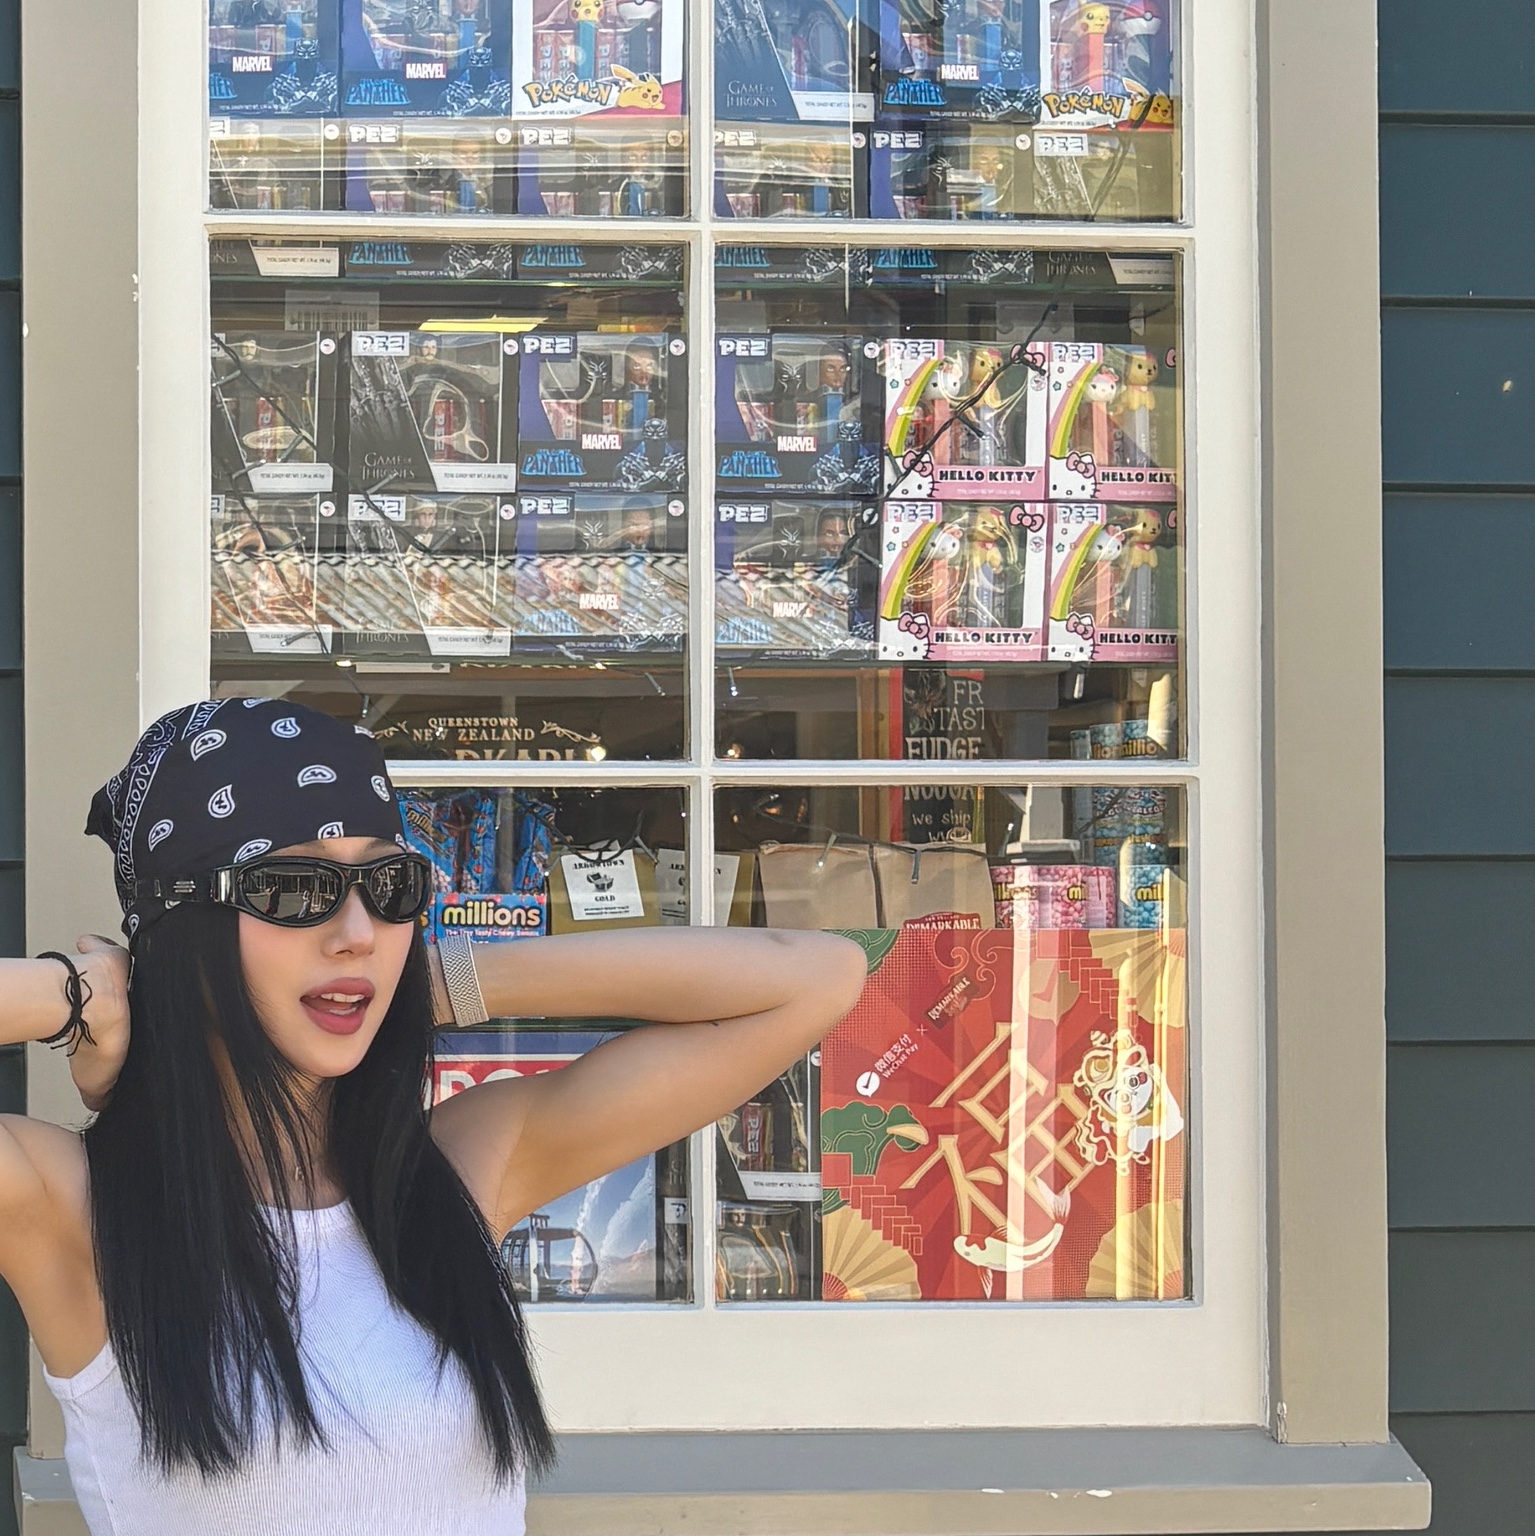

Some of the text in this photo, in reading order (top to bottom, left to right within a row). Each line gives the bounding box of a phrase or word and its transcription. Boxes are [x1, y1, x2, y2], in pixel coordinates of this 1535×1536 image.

[232, 56, 273, 72] MARVEL
[405, 63, 446, 79] MARVEL
[941, 64, 979, 81] MARVEL
[728, 80, 763, 94] GAME
[726, 94, 778, 108] THRONES
[348, 124, 400, 143] PEZ
[520, 126, 573, 145] PEZ
[873, 130, 924, 149] PEZ
[1037, 136, 1084, 152] PEZ
[354, 334, 407, 351] PEZ
[522, 335, 574, 354] PEZ
[718, 337, 770, 356] PEZ
[891, 341, 936, 358] PEZ
[1053, 343, 1095, 360] PEZ
[581, 434, 622, 450] MARVEL
[777, 436, 817, 452] MARVEL
[364, 452, 402, 467] GAME
[939, 470, 1036, 482] HELLO KITTY
[1101, 472, 1144, 483] HELLO
[520, 496, 572, 515] PEZ
[718, 503, 770, 523] PEZ
[888, 504, 934, 521] PEZ
[1057, 505, 1099, 522] PEZ
[579, 593, 620, 610] MARVEL
[773, 601, 814, 618] MARVL
[354, 630, 409, 643] THRONES
[935, 632, 1033, 643] HELLO KITTY
[1099, 633, 1141, 644] HELLO
[428, 717, 519, 728] QUEENSTOWN
[413, 727, 535, 742] NEW ZEALAND
[905, 736, 982, 760] FUDGE
[912, 808, 972, 829] we ship
[443, 900, 542, 926] millions
